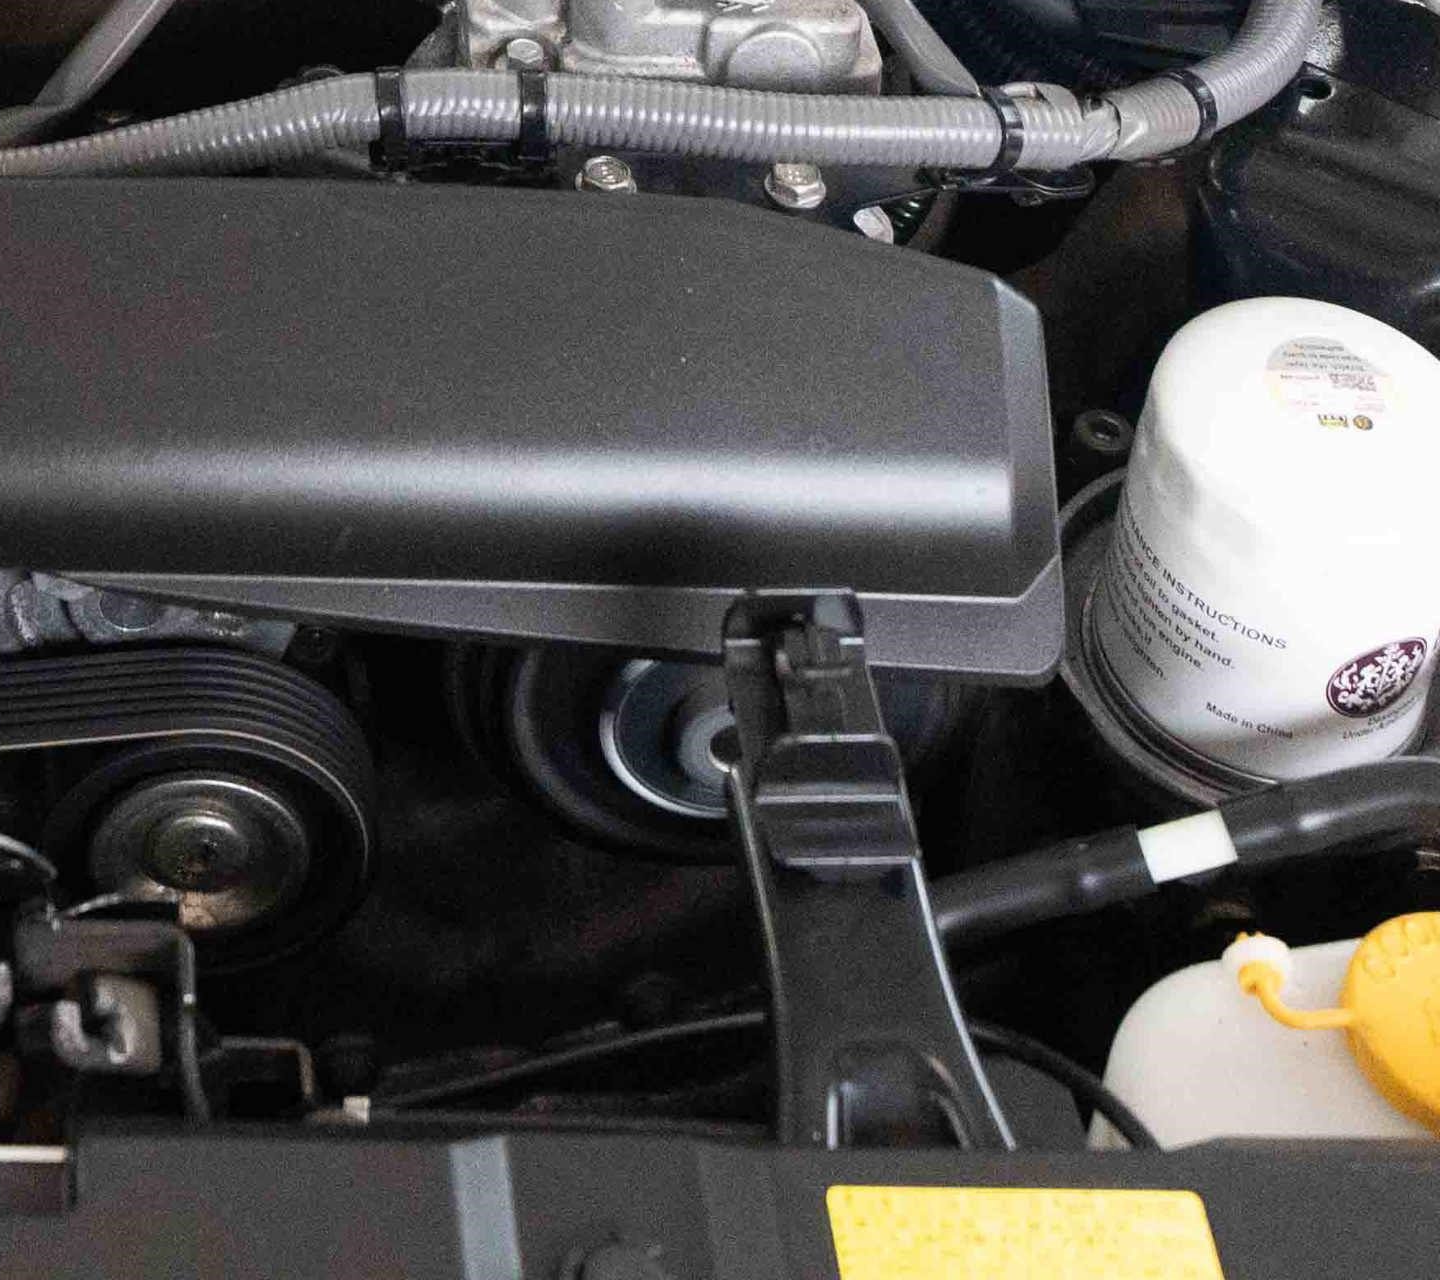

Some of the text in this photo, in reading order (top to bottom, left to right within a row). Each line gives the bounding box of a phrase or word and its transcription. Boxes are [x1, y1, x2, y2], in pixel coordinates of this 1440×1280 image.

[1162, 568, 1288, 650] INSTRUCTIONS
[1171, 604, 1219, 643] gasket.
[1175, 624, 1192, 643] by
[1194, 639, 1236, 669] hand.
[1206, 701, 1294, 740] Made in China
